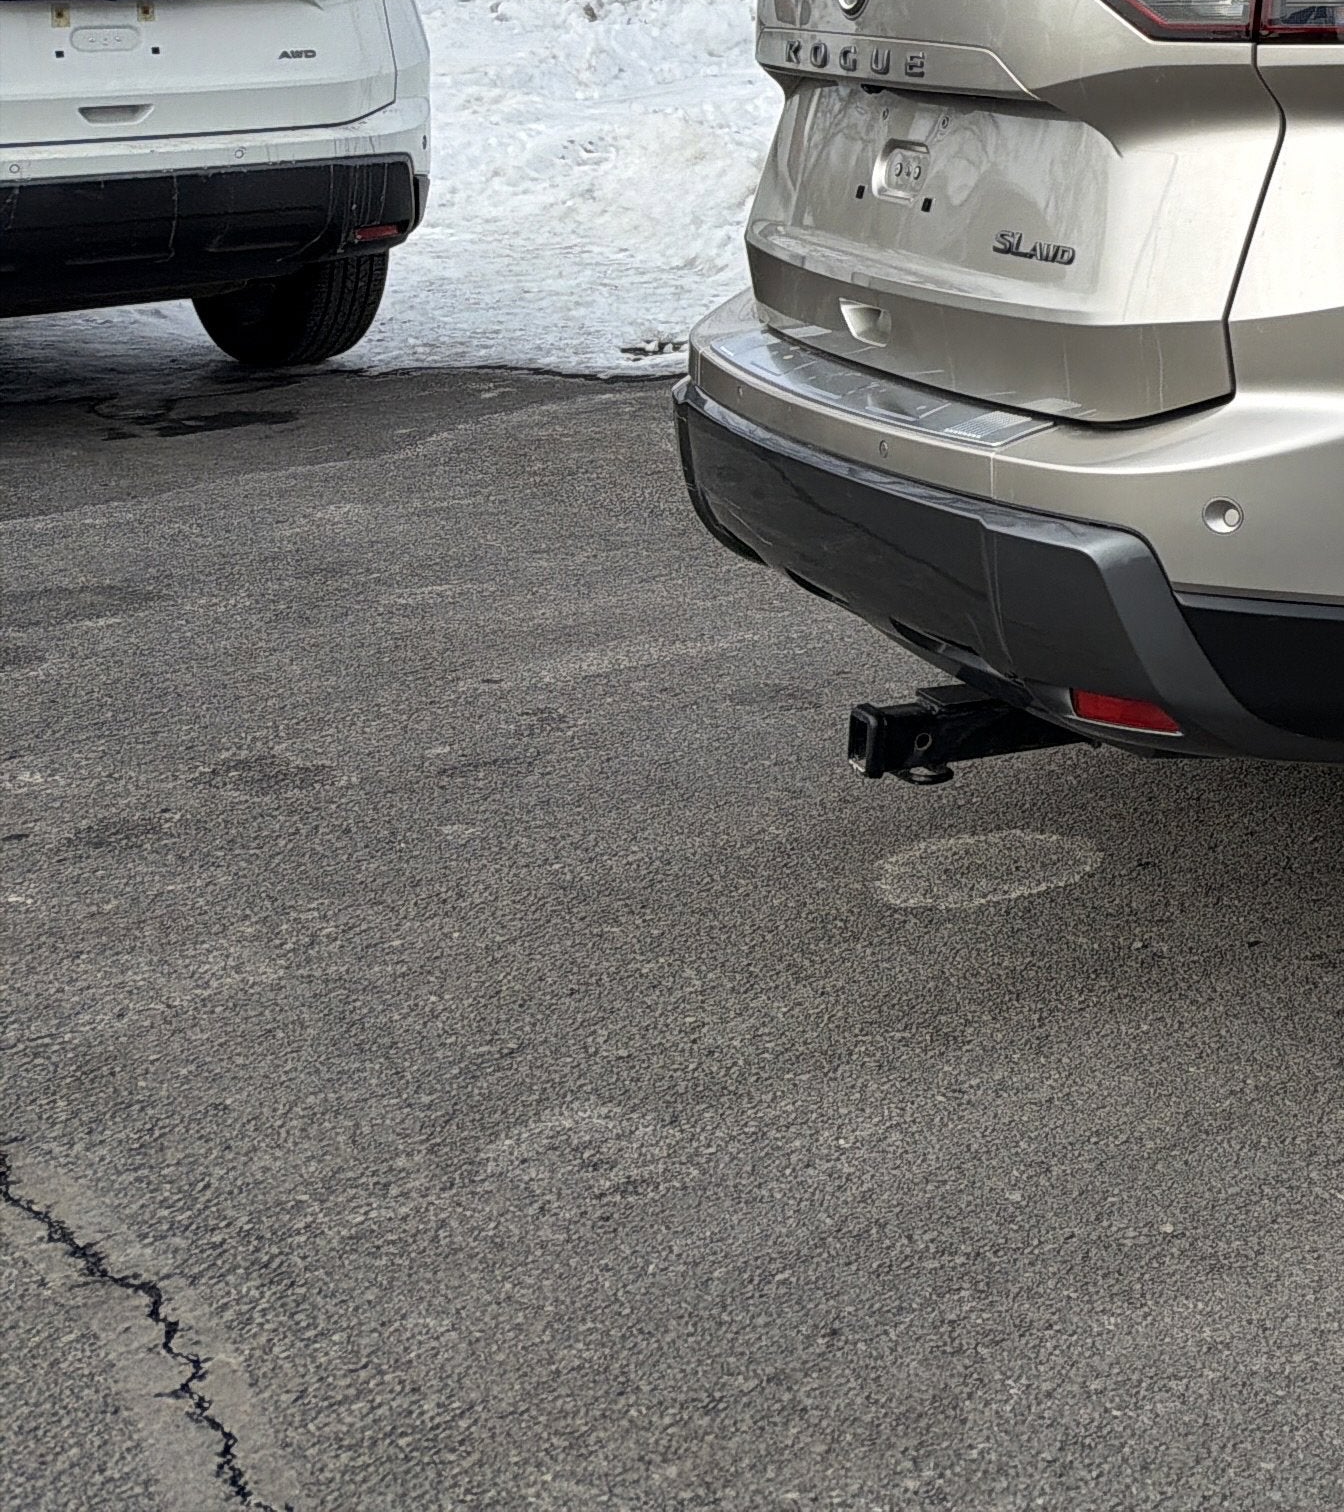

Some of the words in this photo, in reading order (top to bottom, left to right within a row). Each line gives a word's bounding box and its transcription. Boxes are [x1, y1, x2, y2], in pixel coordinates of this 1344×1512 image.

[278, 49, 317, 60] AWD
[784, 39, 926, 79] ROGUE
[992, 230, 1033, 260] SL
[1030, 241, 1076, 266] AWD
